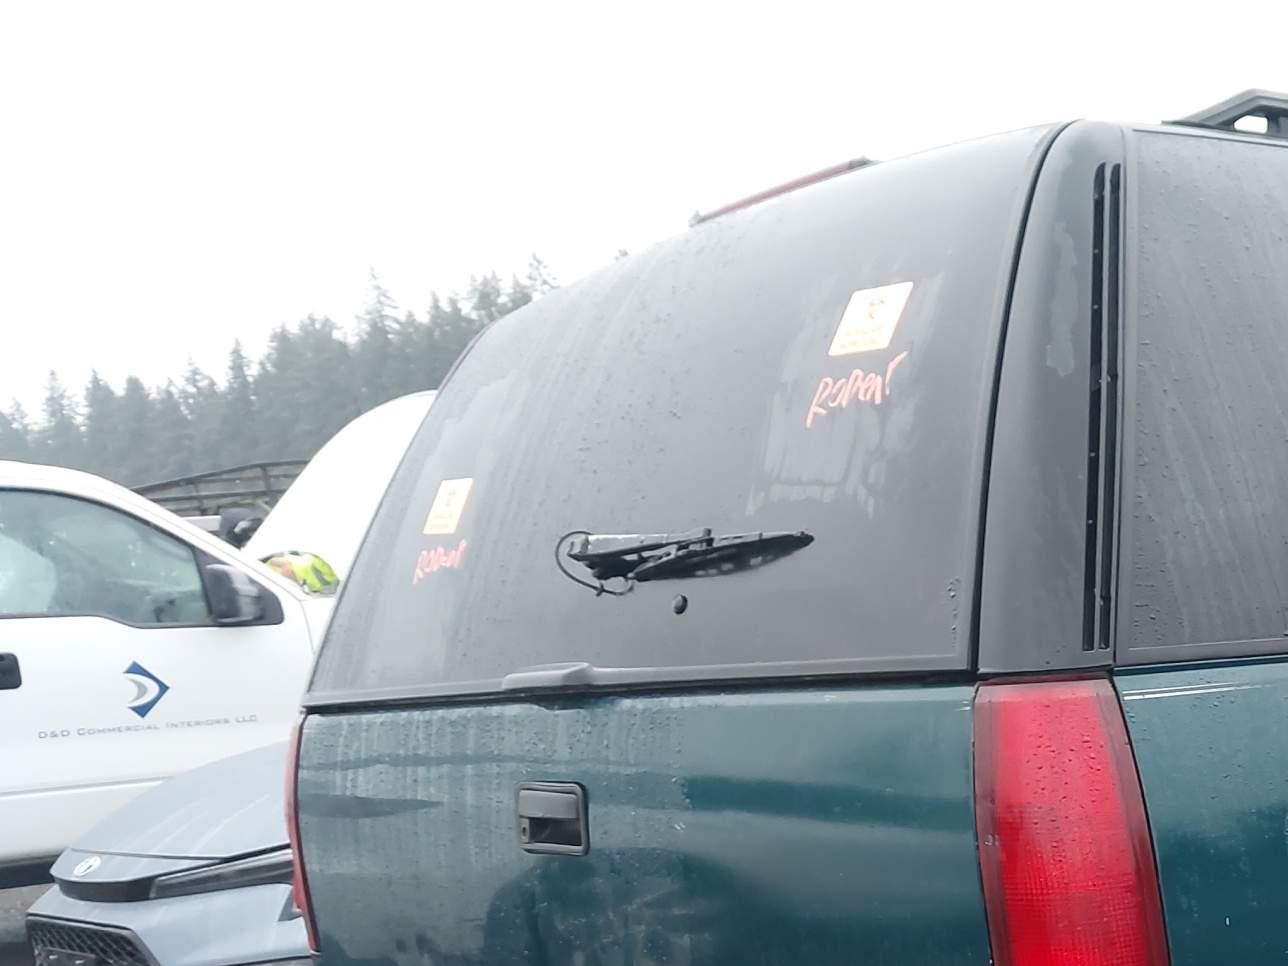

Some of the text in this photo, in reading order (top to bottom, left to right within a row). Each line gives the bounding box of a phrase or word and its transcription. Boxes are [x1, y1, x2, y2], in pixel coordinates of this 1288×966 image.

[38, 714, 257, 739] D&D COMMERCIAL INTERIORS LLC
